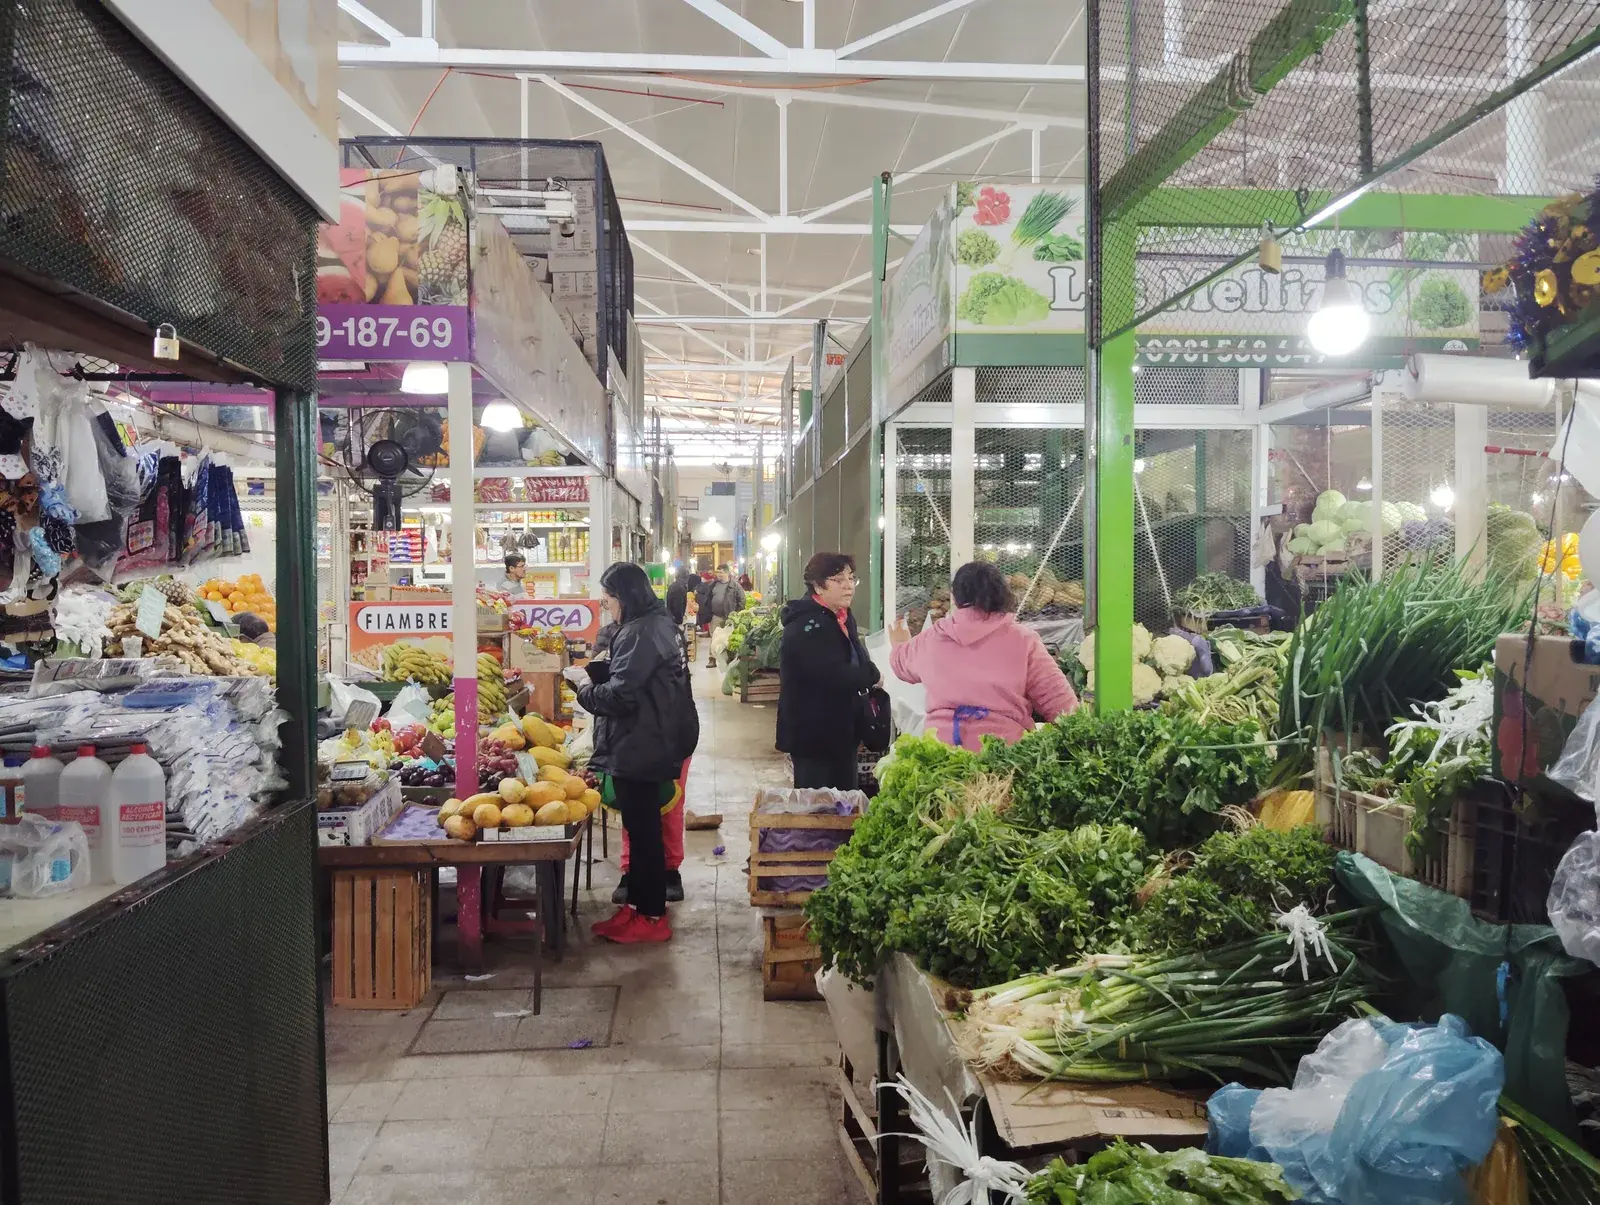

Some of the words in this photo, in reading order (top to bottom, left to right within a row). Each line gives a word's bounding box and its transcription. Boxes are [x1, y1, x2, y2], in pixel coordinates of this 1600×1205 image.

[1159, 267, 1393, 315] Mellizs
[316, 316, 452, 348] 9-187-69
[365, 612, 448, 630] FIAMBRE
